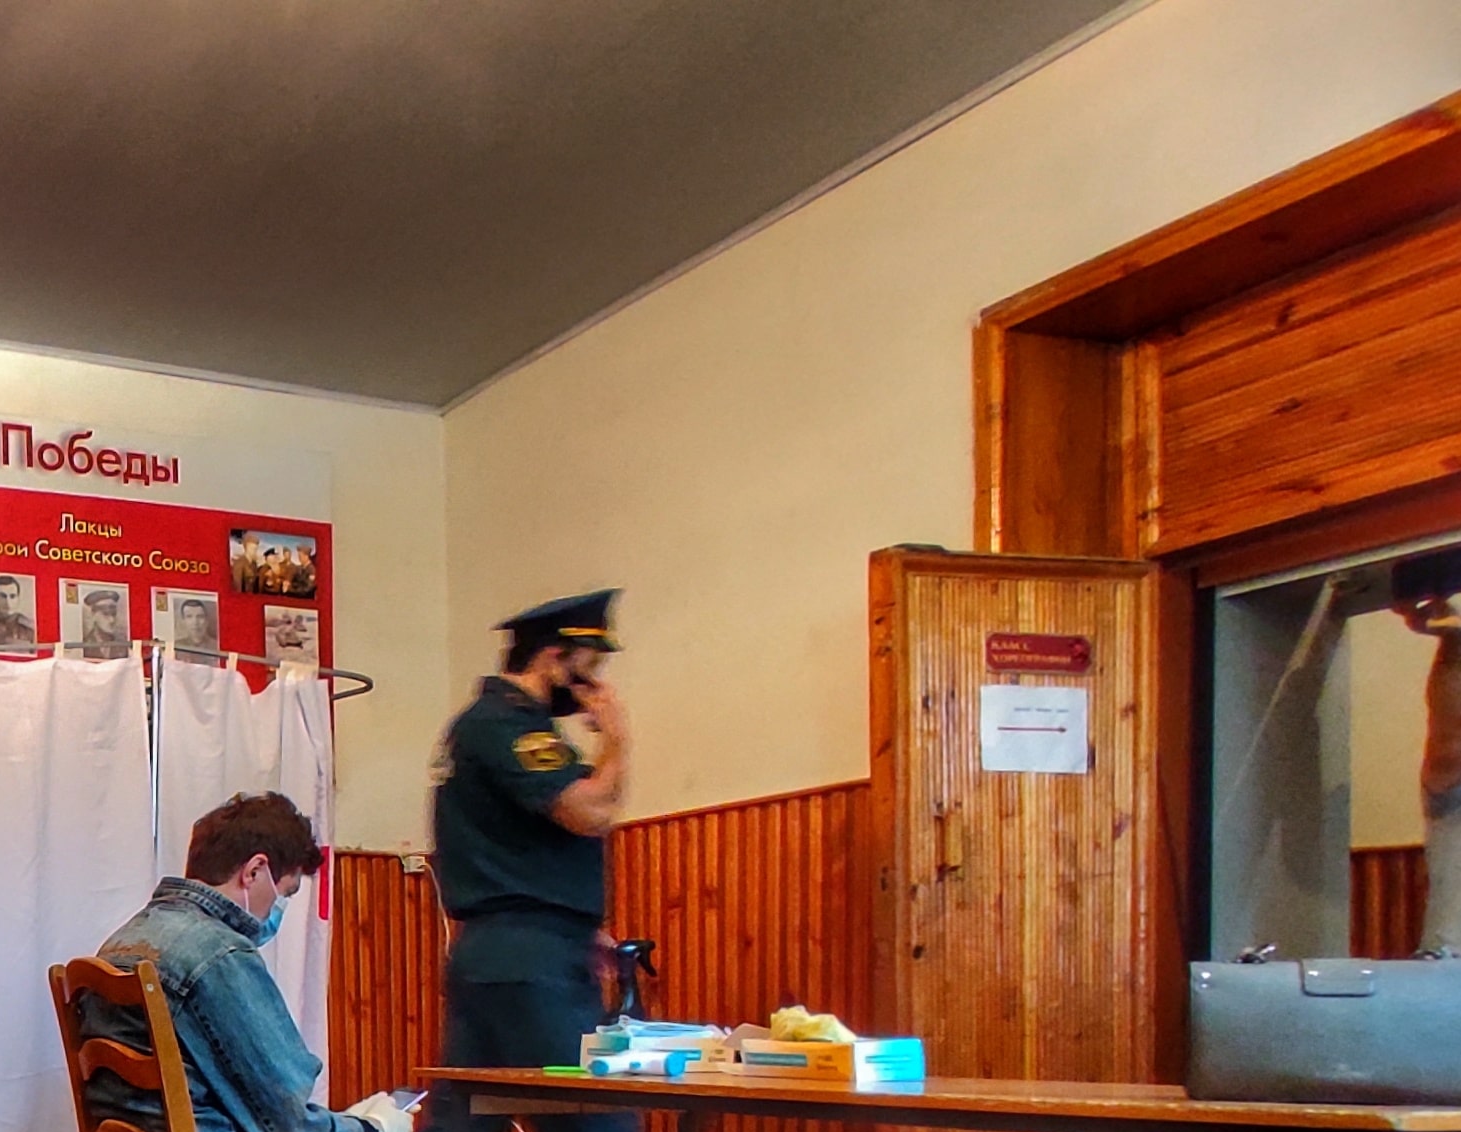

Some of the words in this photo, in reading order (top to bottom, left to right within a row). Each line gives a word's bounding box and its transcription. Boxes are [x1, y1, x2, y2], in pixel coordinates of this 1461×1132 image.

[1, 422, 180, 487] Победы
[59, 512, 123, 539] Лакцы
[35, 539, 144, 569] Советского
[148, 550, 211, 574] Союза
